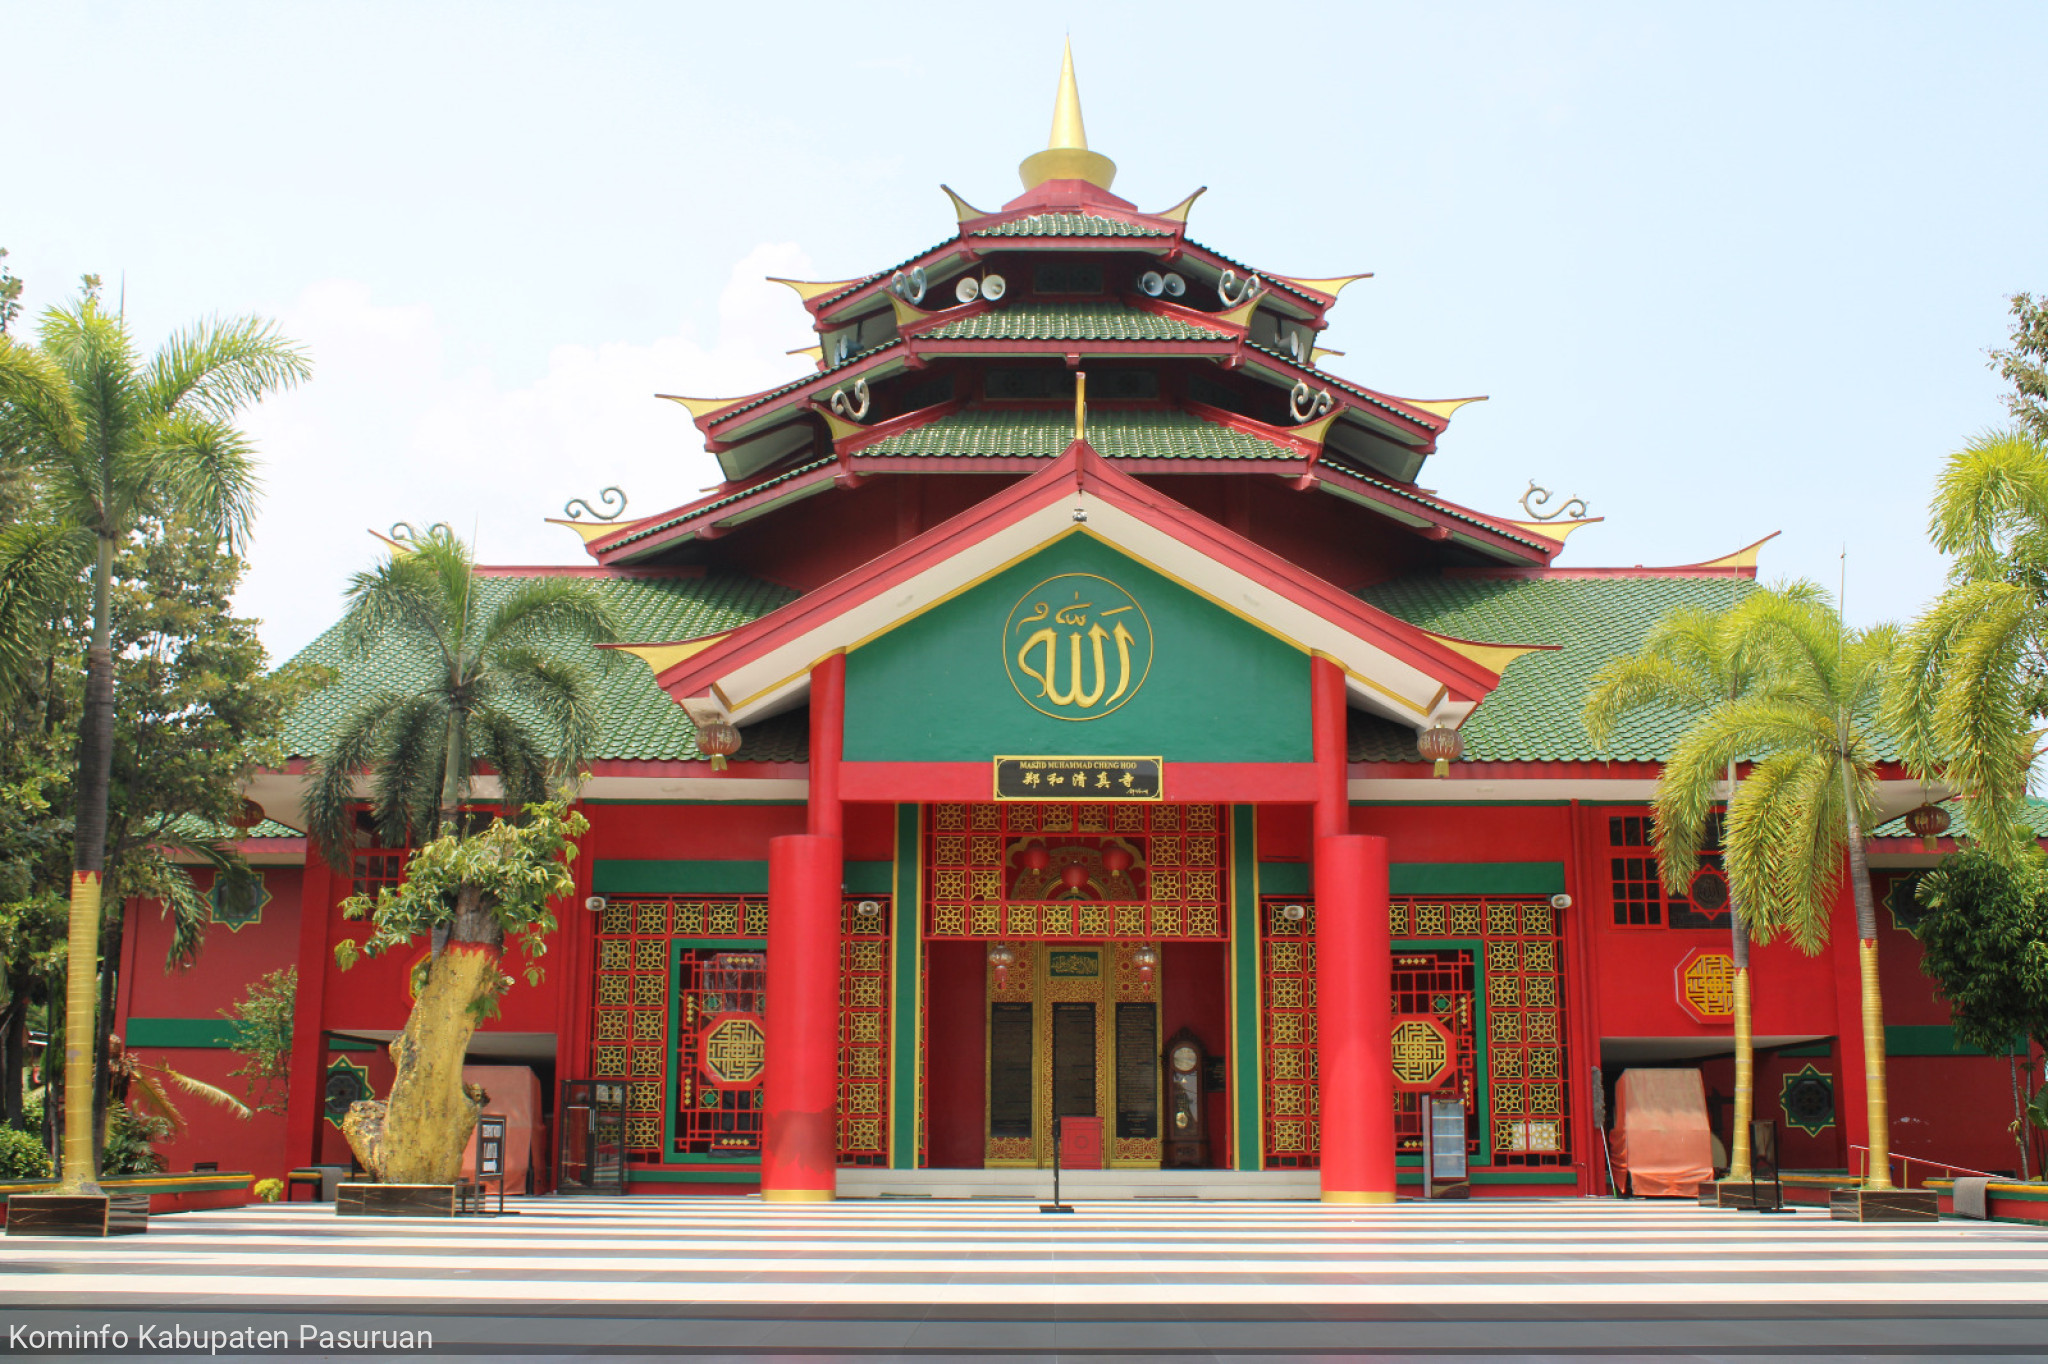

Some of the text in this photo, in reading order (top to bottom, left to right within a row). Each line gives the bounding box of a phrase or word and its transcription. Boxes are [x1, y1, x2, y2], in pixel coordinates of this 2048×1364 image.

[1020, 761, 1137, 769] MASJID MUHAMMAD CHENG HOO
